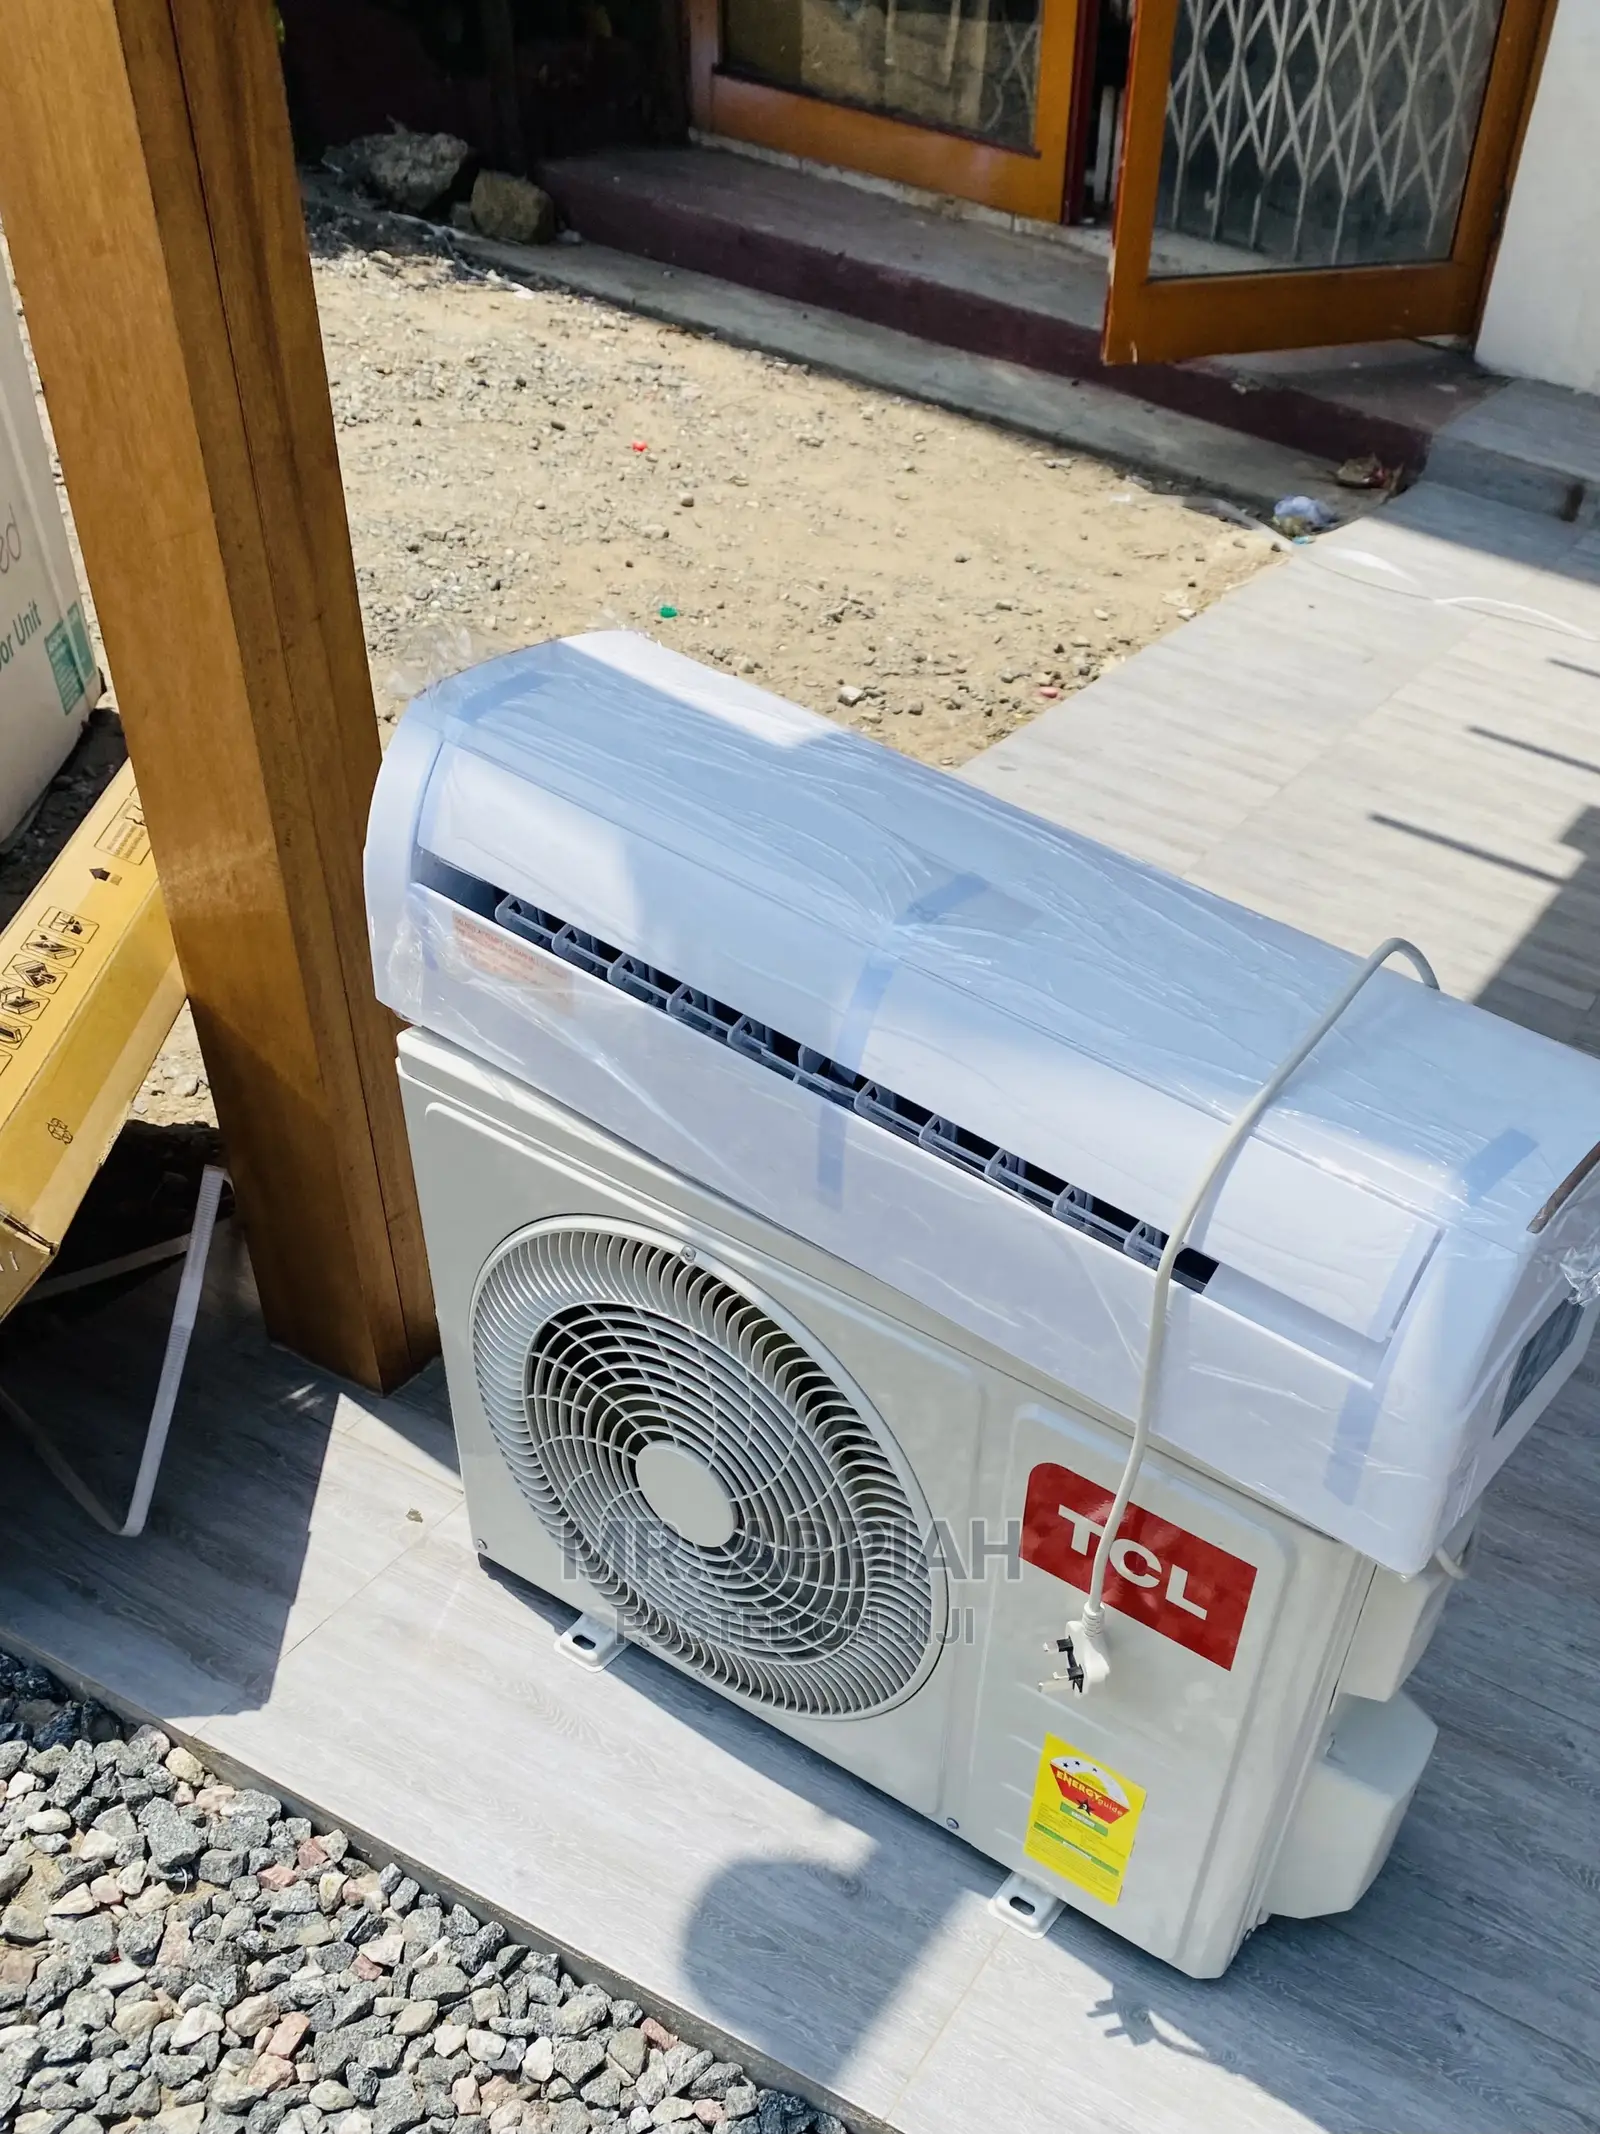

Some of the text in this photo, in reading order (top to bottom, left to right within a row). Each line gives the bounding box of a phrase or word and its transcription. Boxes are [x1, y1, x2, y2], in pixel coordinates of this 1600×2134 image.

[12, 600, 42, 646] Unit
[1057, 1504, 1207, 1620] TCL
[1056, 1770, 1102, 1801] ENERGY
[1097, 1799, 1124, 1816] guide
